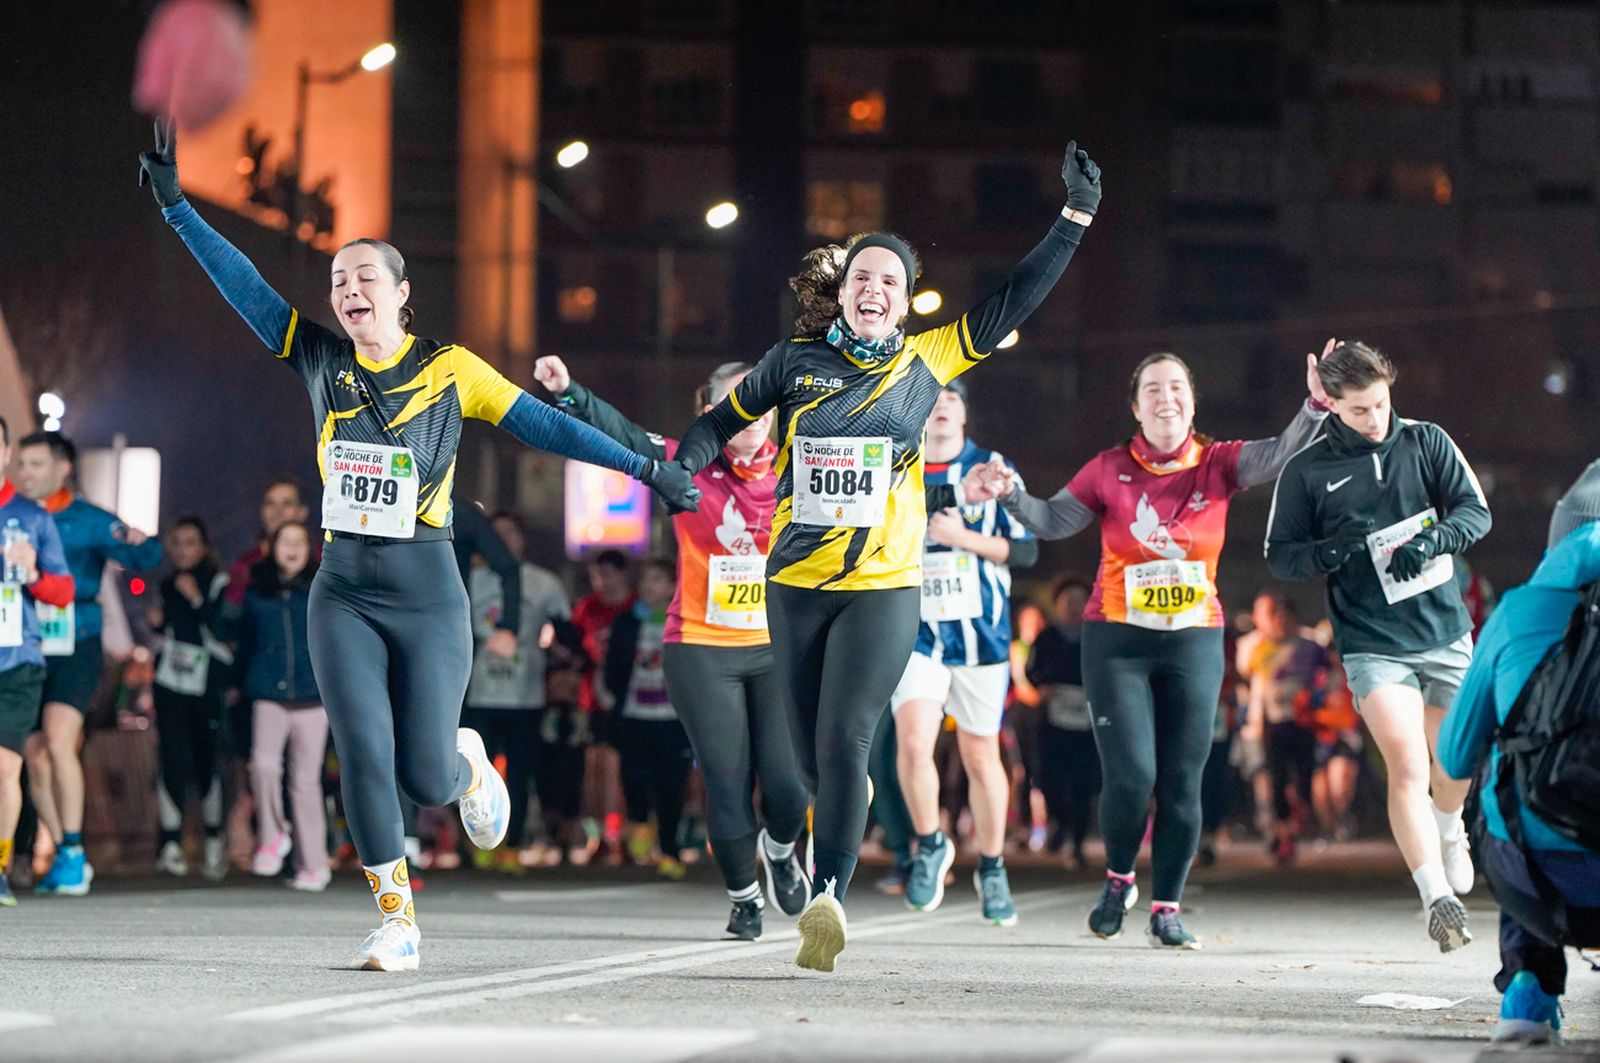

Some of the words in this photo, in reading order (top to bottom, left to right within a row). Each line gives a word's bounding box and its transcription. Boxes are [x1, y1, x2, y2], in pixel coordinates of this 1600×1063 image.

[343, 451, 371, 463] NOCHE
[372, 454, 383, 464] DE
[814, 447, 841, 456] NOCHE
[843, 447, 855, 456] DE
[334, 461, 350, 471] SAN
[351, 463, 383, 475] ANTÓN
[804, 456, 822, 466] SAN
[822, 456, 855, 467] ANTÓN
[340, 474, 398, 506] 6879
[809, 468, 873, 496] 5084
[728, 583, 765, 604] 720
[1143, 586, 1195, 608] 2094
